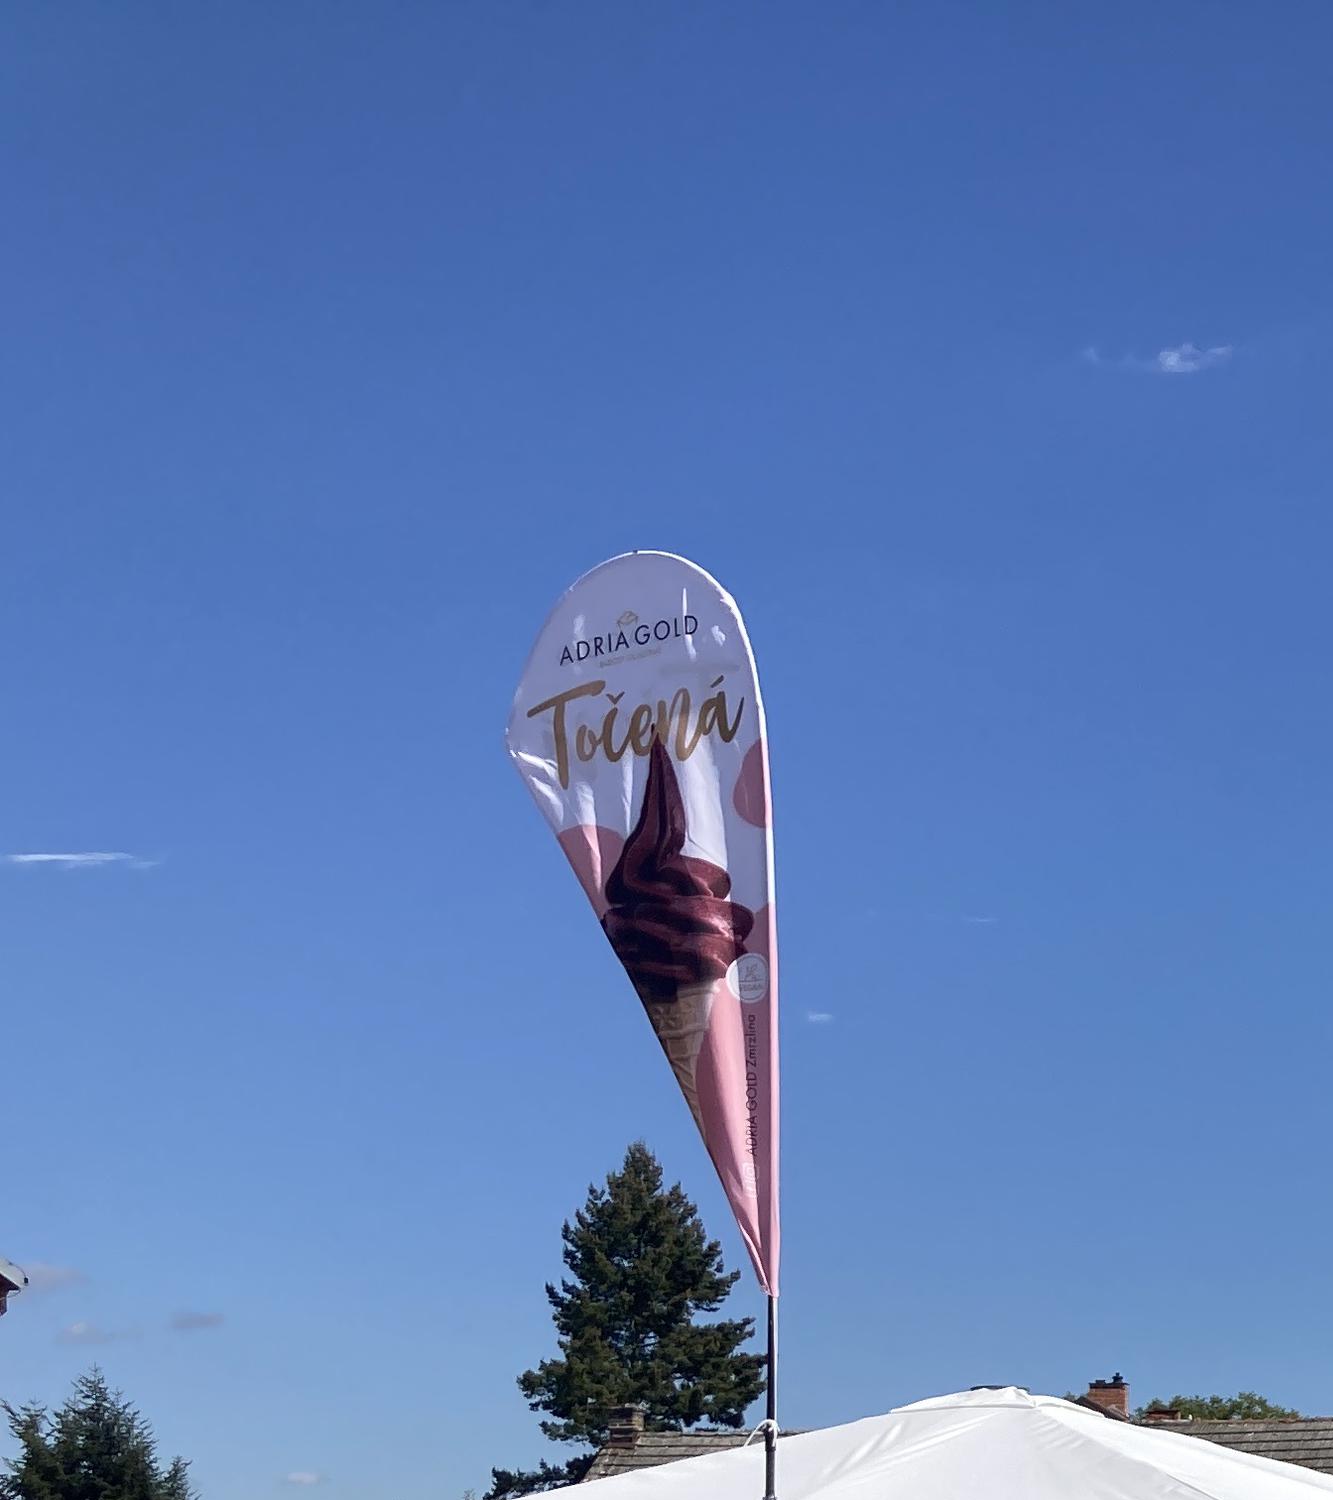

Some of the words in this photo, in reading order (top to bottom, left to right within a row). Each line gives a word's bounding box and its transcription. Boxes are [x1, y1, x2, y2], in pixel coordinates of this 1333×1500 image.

[559, 631, 630, 667] ADRIA
[634, 615, 698, 646] GOLD
[527, 675, 745, 791] Točená
